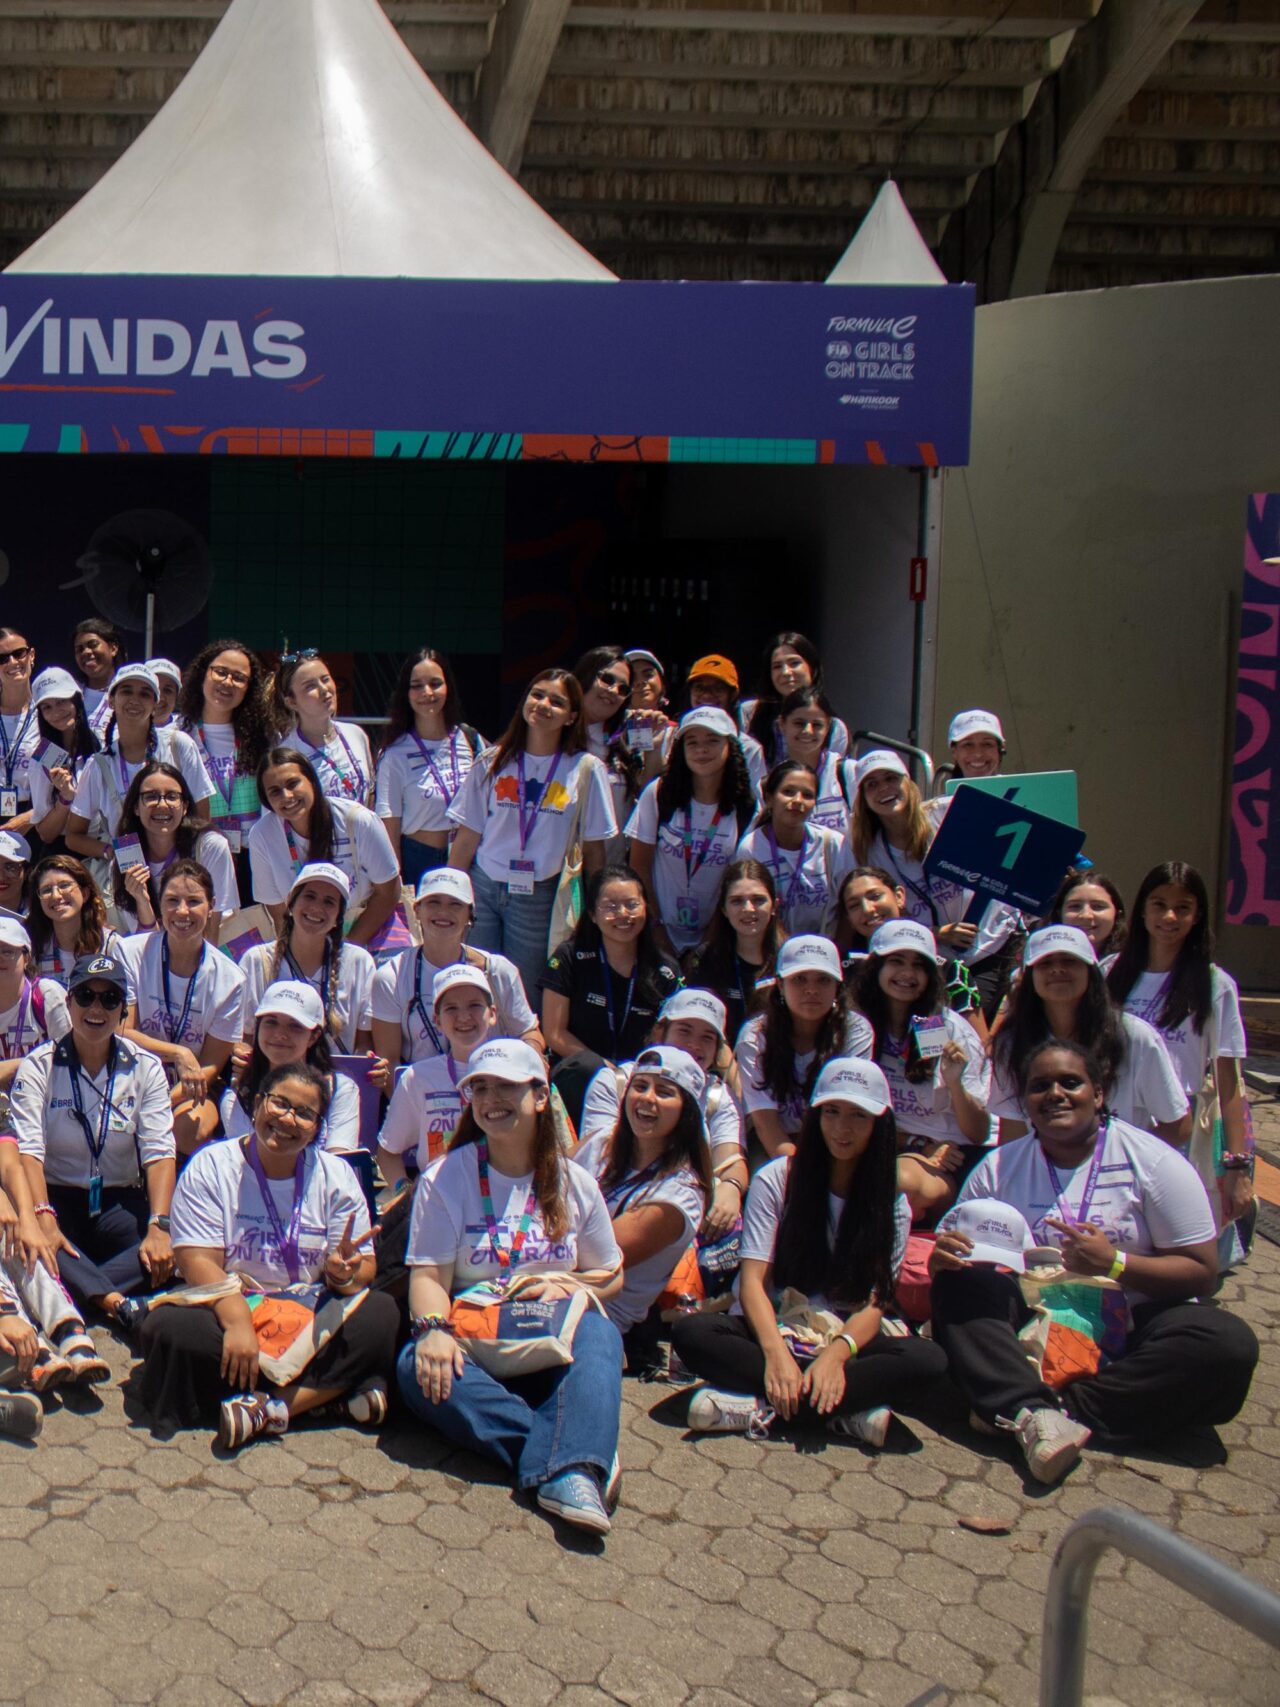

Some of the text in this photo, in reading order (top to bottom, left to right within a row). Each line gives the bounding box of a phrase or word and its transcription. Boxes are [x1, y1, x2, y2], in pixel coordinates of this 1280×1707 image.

[855, 342, 915, 360] GIRLS
[825, 361, 915, 380] ON TRACK
[995, 820, 1032, 870] 1
[894, 1102, 936, 1117] RACK
[428, 1118, 455, 1133] ON
[983, 1219, 1008, 1230] GIRLS
[989, 1226, 1013, 1238] TRACK
[224, 1243, 320, 1266] ON TRCK
[523, 1245, 574, 1264] RACK
